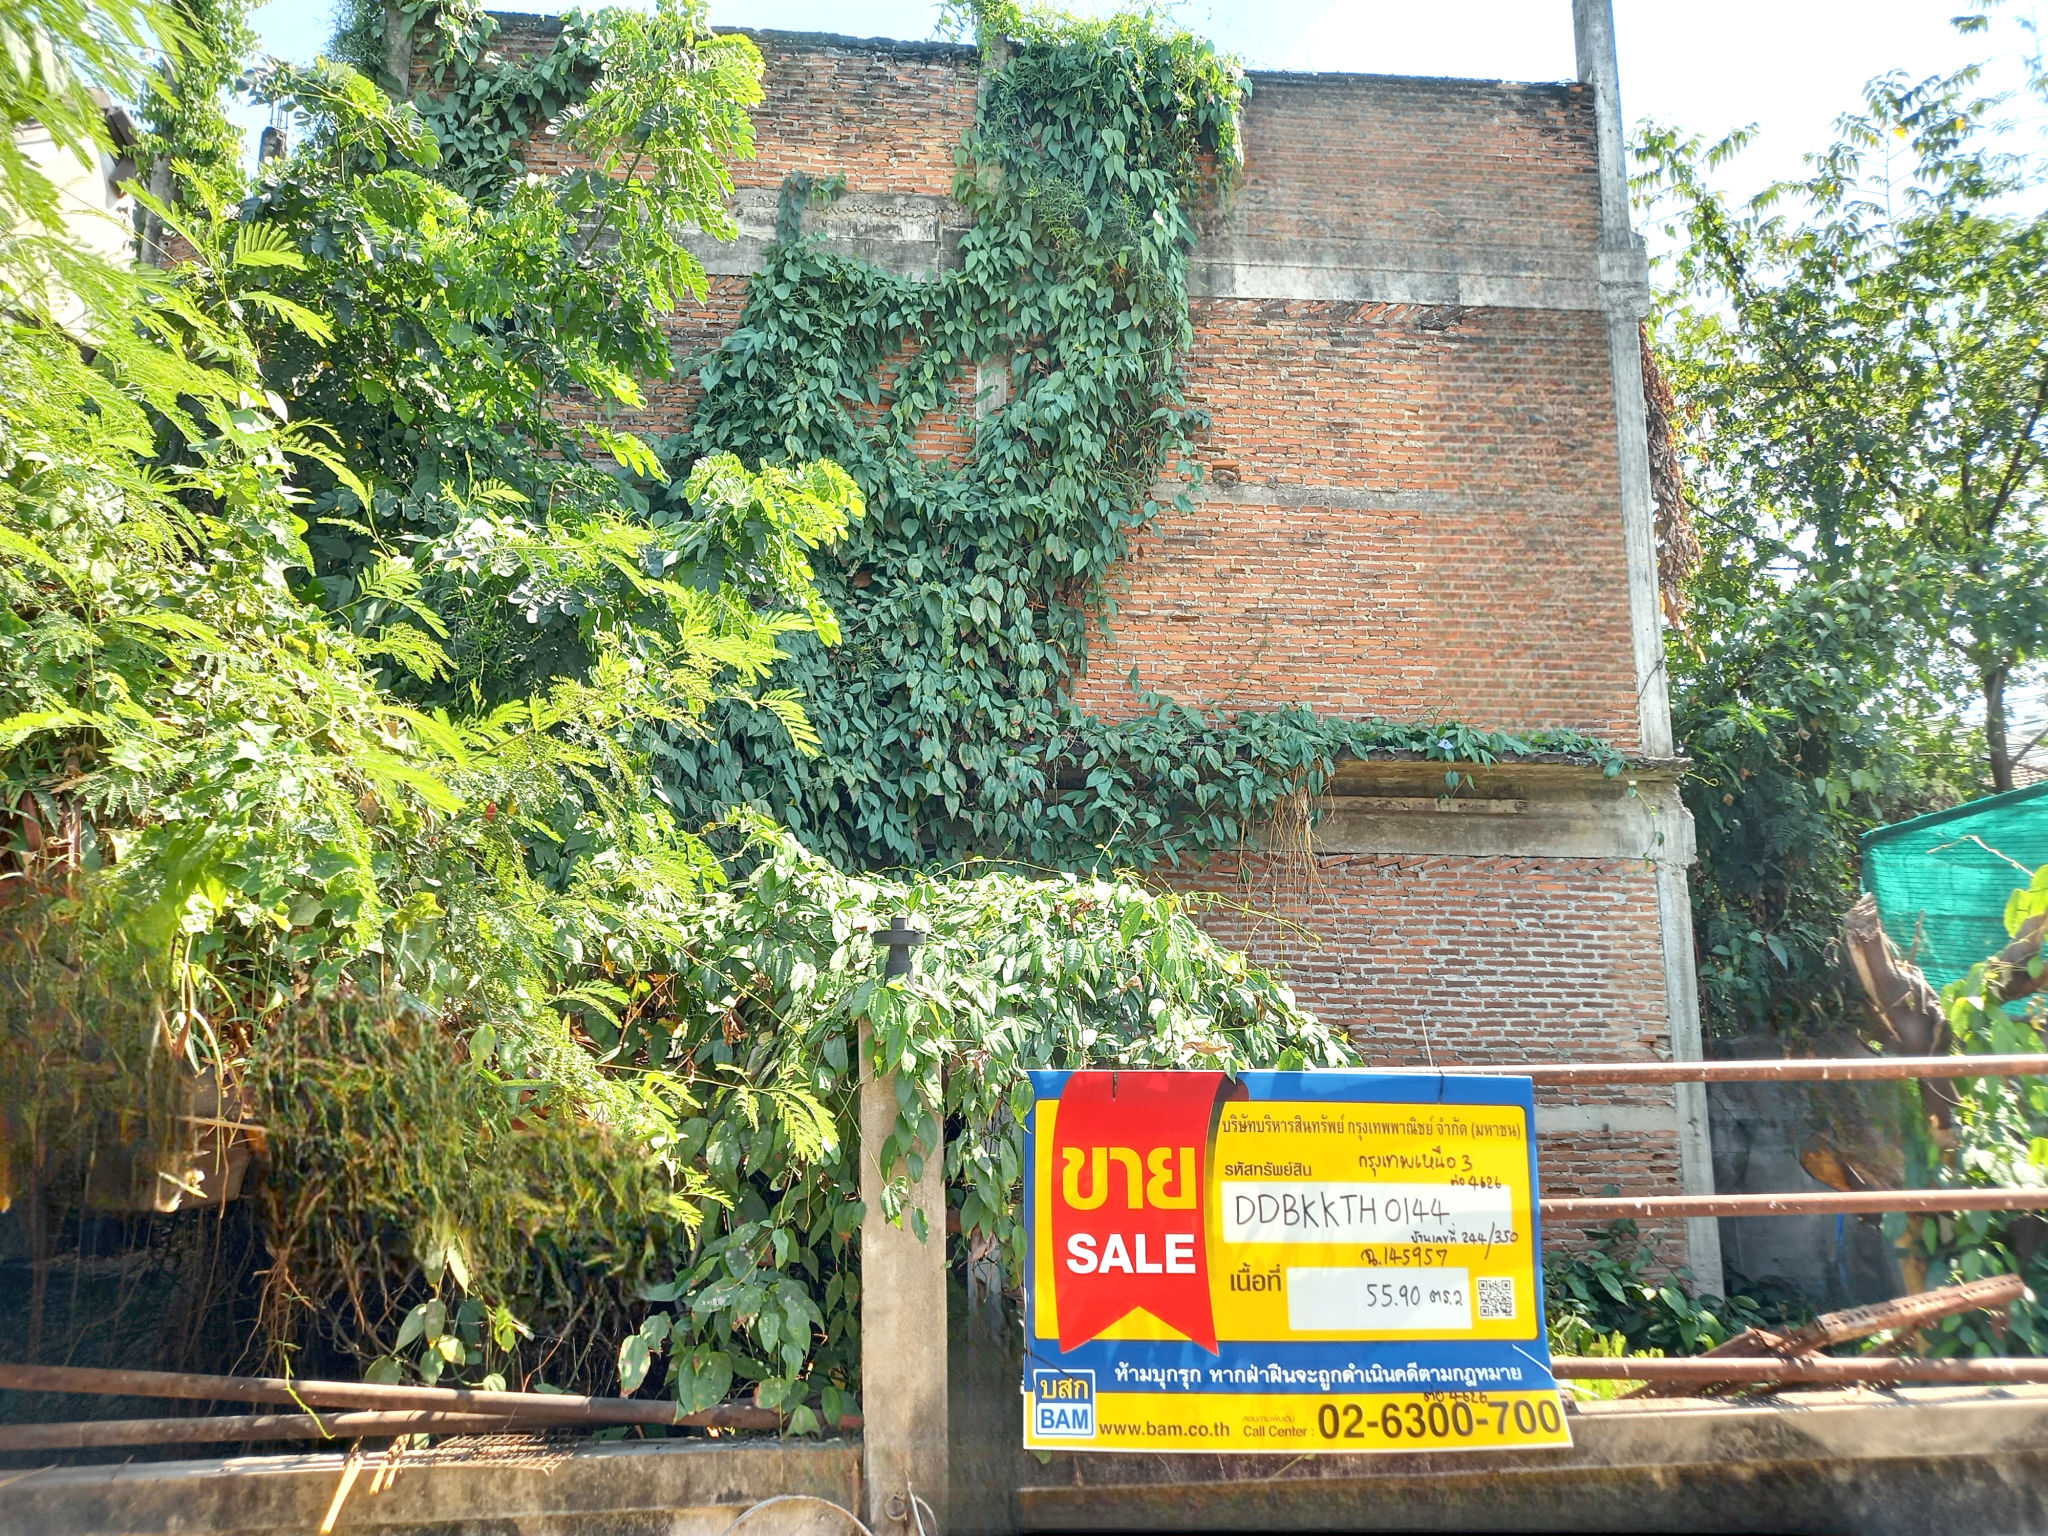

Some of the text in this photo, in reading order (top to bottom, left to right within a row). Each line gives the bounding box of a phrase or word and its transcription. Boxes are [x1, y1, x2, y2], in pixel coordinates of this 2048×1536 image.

[1222, 1114, 1521, 1141] บริษัทบริหารสินทรัพย์ กรุงเทพพาณิชย์ จำกัด (มหาชน)
[1224, 1161, 1312, 1177] รหัสทรัพย์สิน
[1461, 1154, 1473, 1172] 3
[1062, 1147, 1197, 1210] ขาย
[1066, 1233, 1196, 1274] SALE
[1230, 1262, 1282, 1292] เนื้อที่
[1366, 1283, 1421, 1307] 55.90
[1039, 1375, 1089, 1400] บสก
[1114, 1361, 1202, 1390] ห้ามบุกรุก
[1040, 1407, 1089, 1430] BAM
[1099, 1421, 1230, 1437] www.bam.co.th
[1243, 1425, 1265, 1437] Call
[1269, 1425, 1307, 1437] Center
[1318, 1399, 1561, 1439] 02-6300-700
